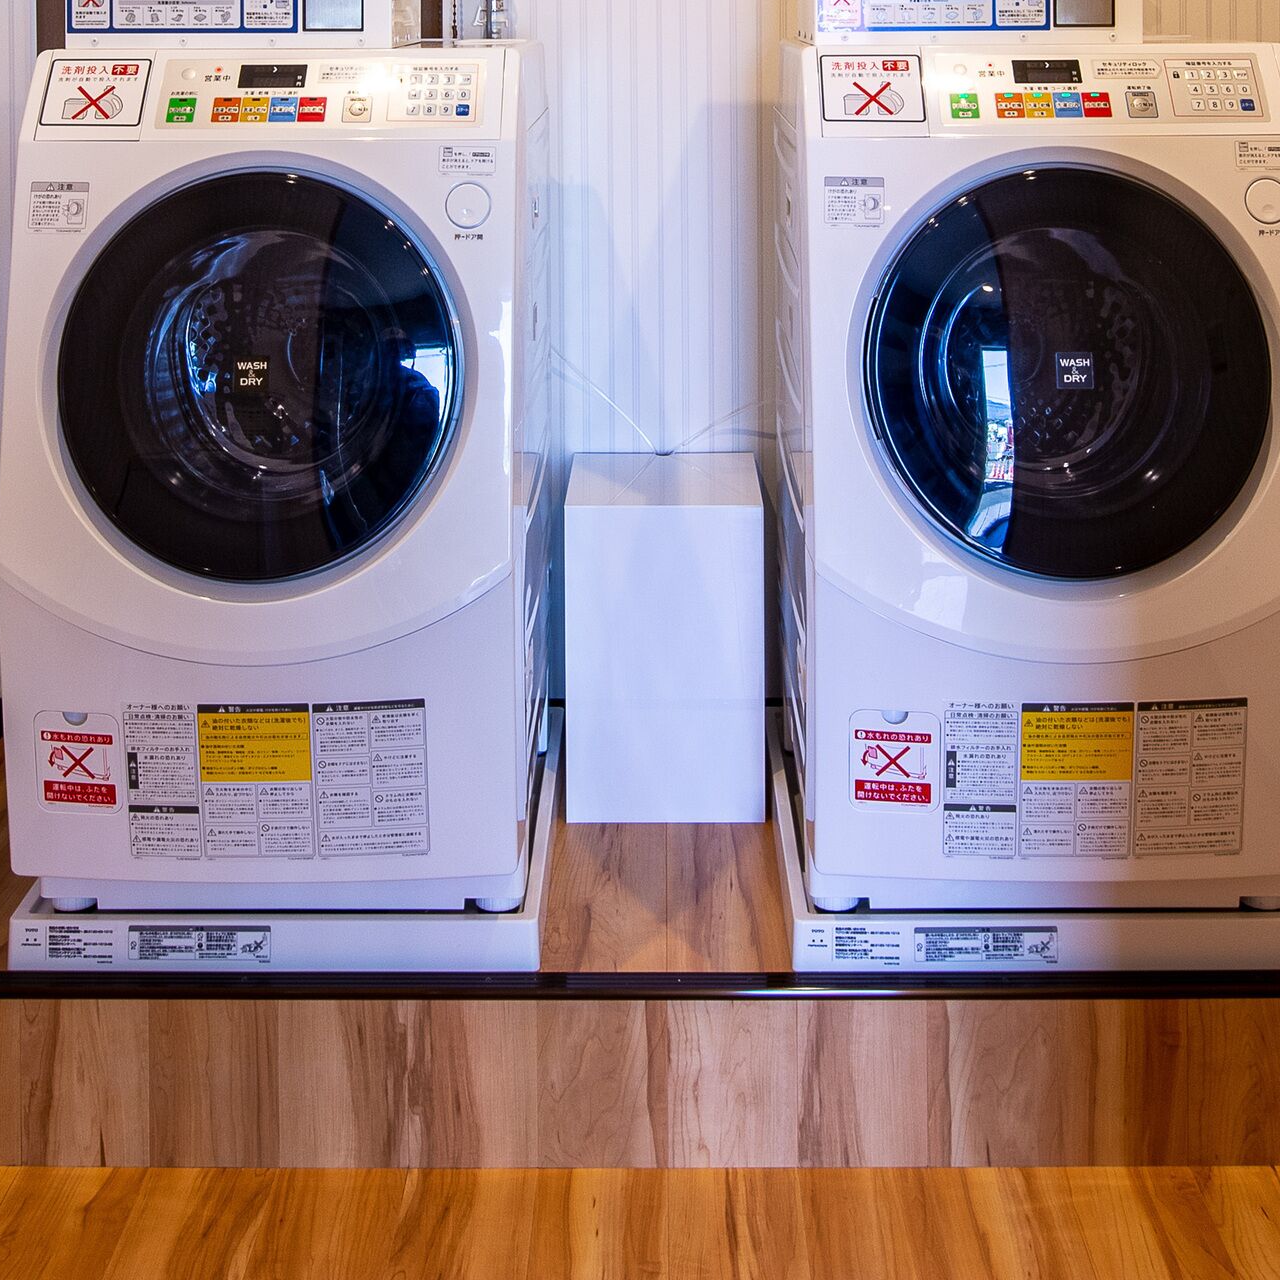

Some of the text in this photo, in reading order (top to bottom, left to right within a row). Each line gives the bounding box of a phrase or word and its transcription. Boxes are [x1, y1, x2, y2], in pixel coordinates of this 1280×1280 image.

[62, 65, 138, 75] 洗剤投入 不要
[832, 61, 908, 71] 洗剤投入 不要
[237, 361, 267, 370] WASH
[1060, 358, 1090, 367] WASH
[1071, 366, 1079, 374] &
[240, 377, 263, 386] DRY
[1064, 374, 1087, 383] DRY
[52, 733, 110, 743] 水もれの恐れあり
[867, 733, 928, 742] 水もれの恐れあり
[52, 783, 108, 794] 運転中は、ふたを
[864, 782, 922, 792] 運転中は、ふたを
[46, 792, 114, 803] 開けないでください。
[857, 791, 929, 802] 開けないでください。
